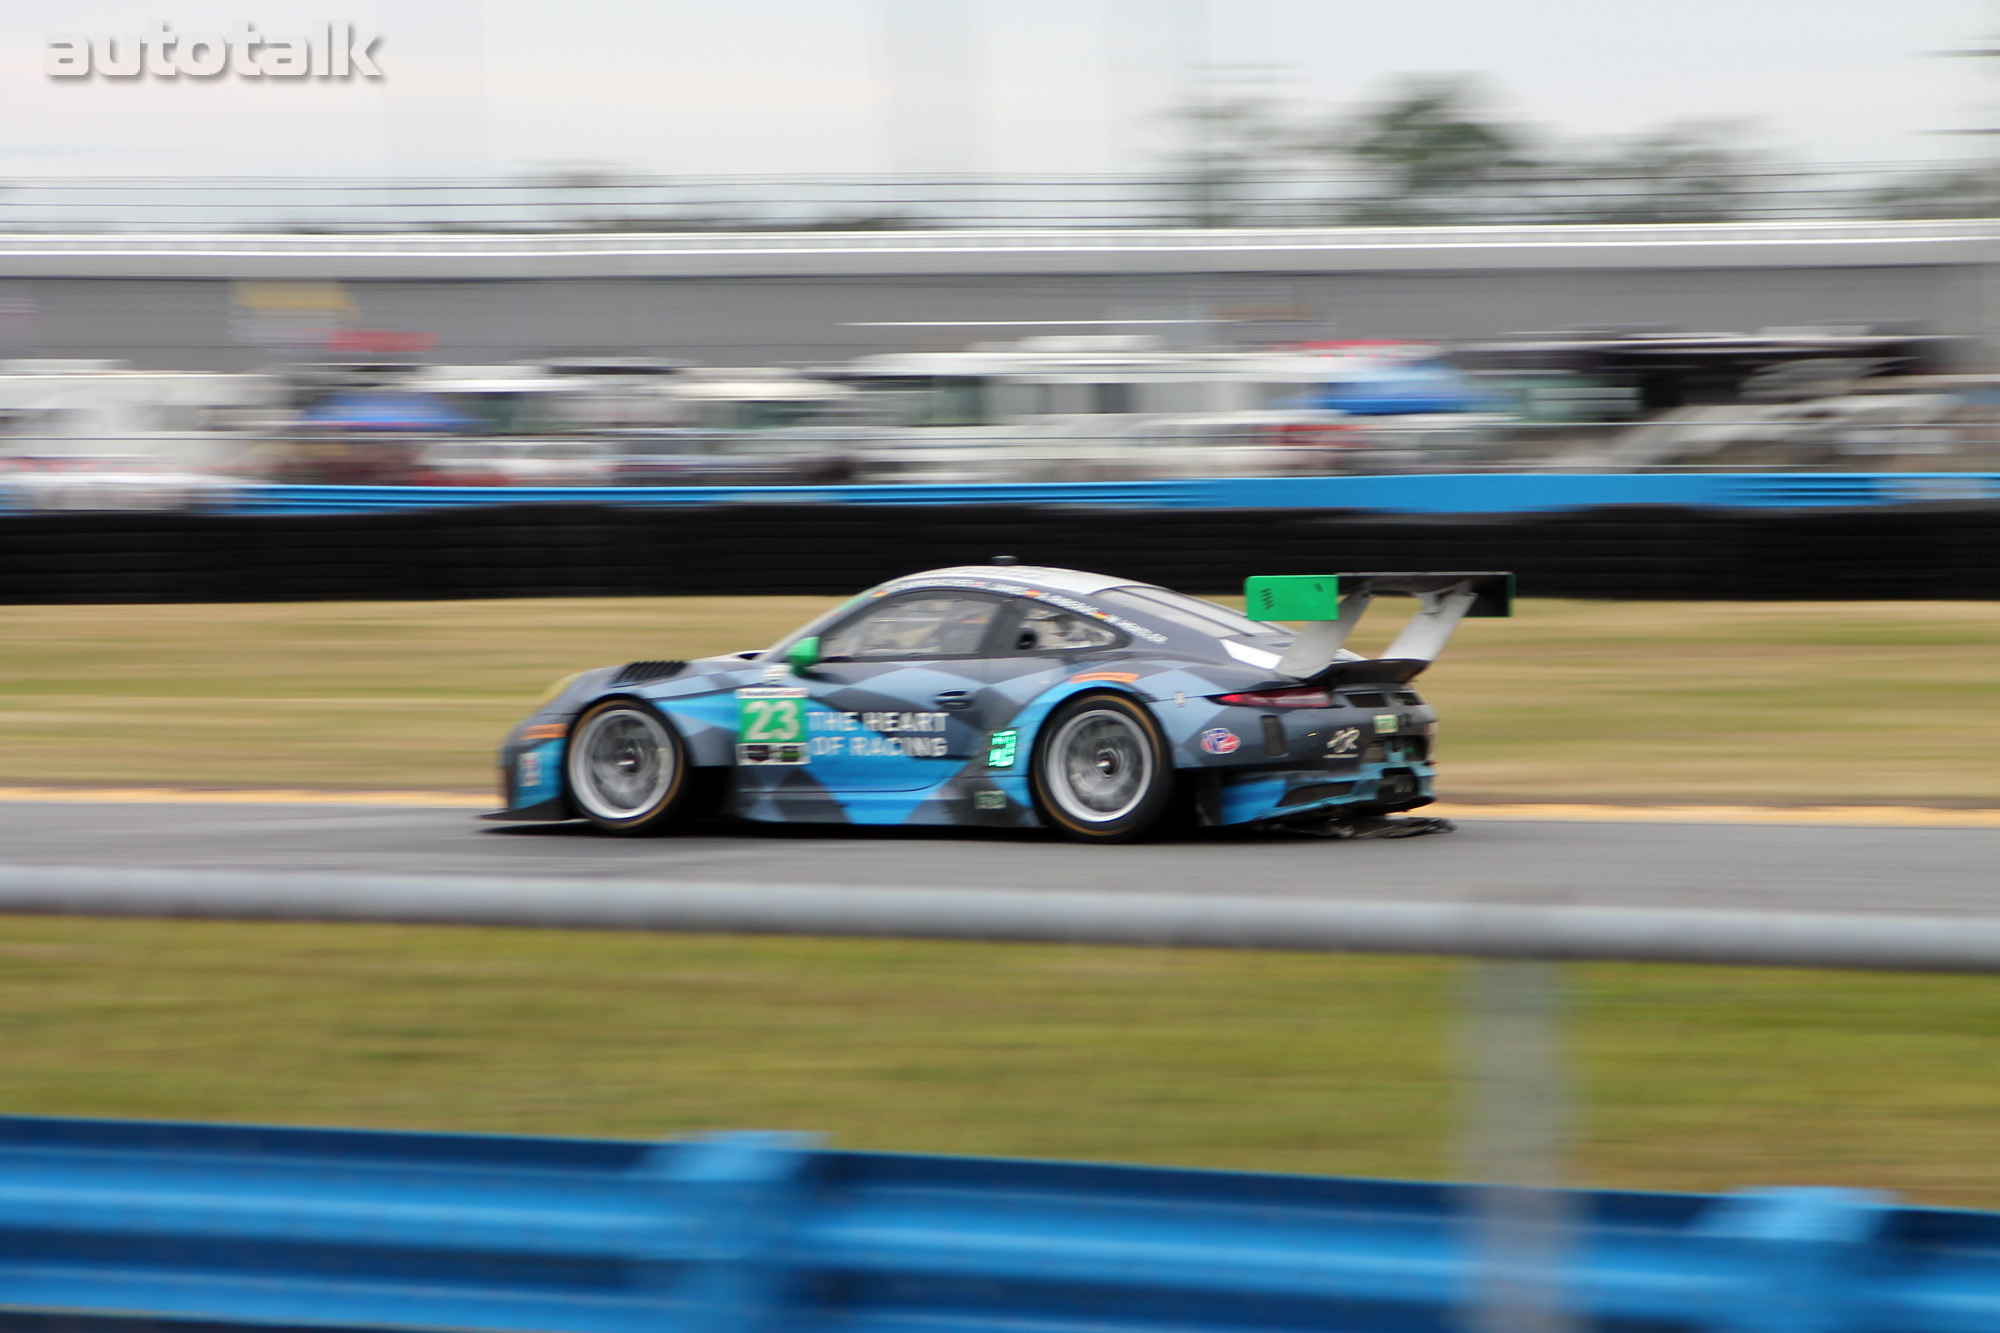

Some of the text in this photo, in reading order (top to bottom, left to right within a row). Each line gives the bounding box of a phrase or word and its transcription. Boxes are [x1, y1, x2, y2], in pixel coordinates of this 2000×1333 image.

[743, 700, 800, 741] 23
[806, 711, 949, 732] THE HEART
[807, 736, 845, 757] OF
[849, 737, 947, 757] RACING
